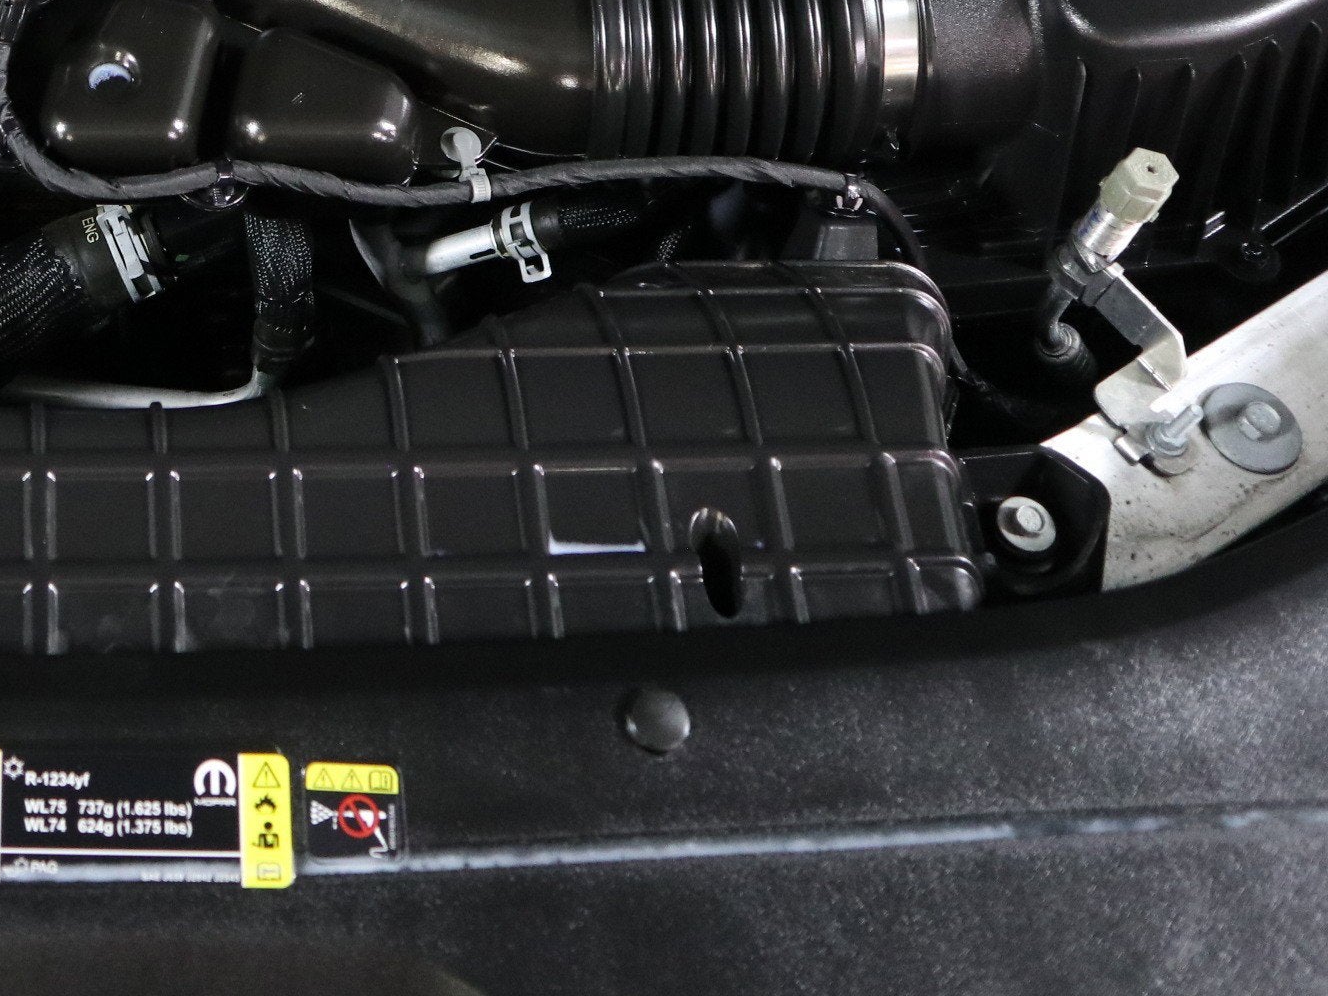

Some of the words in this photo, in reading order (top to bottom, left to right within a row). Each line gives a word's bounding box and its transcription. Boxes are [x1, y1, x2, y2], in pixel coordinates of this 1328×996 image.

[82, 216, 100, 244] ENG
[24, 771, 90, 790] R-1234yf
[24, 798, 68, 815] WL75
[77, 799, 114, 819] 737g
[116, 800, 162, 820] (1.625
[163, 800, 193, 820] lbs)
[24, 816, 68, 833] WL74
[76, 818, 114, 837] 624g
[116, 819, 162, 838] (1.375
[163, 820, 193, 838] lbs)
